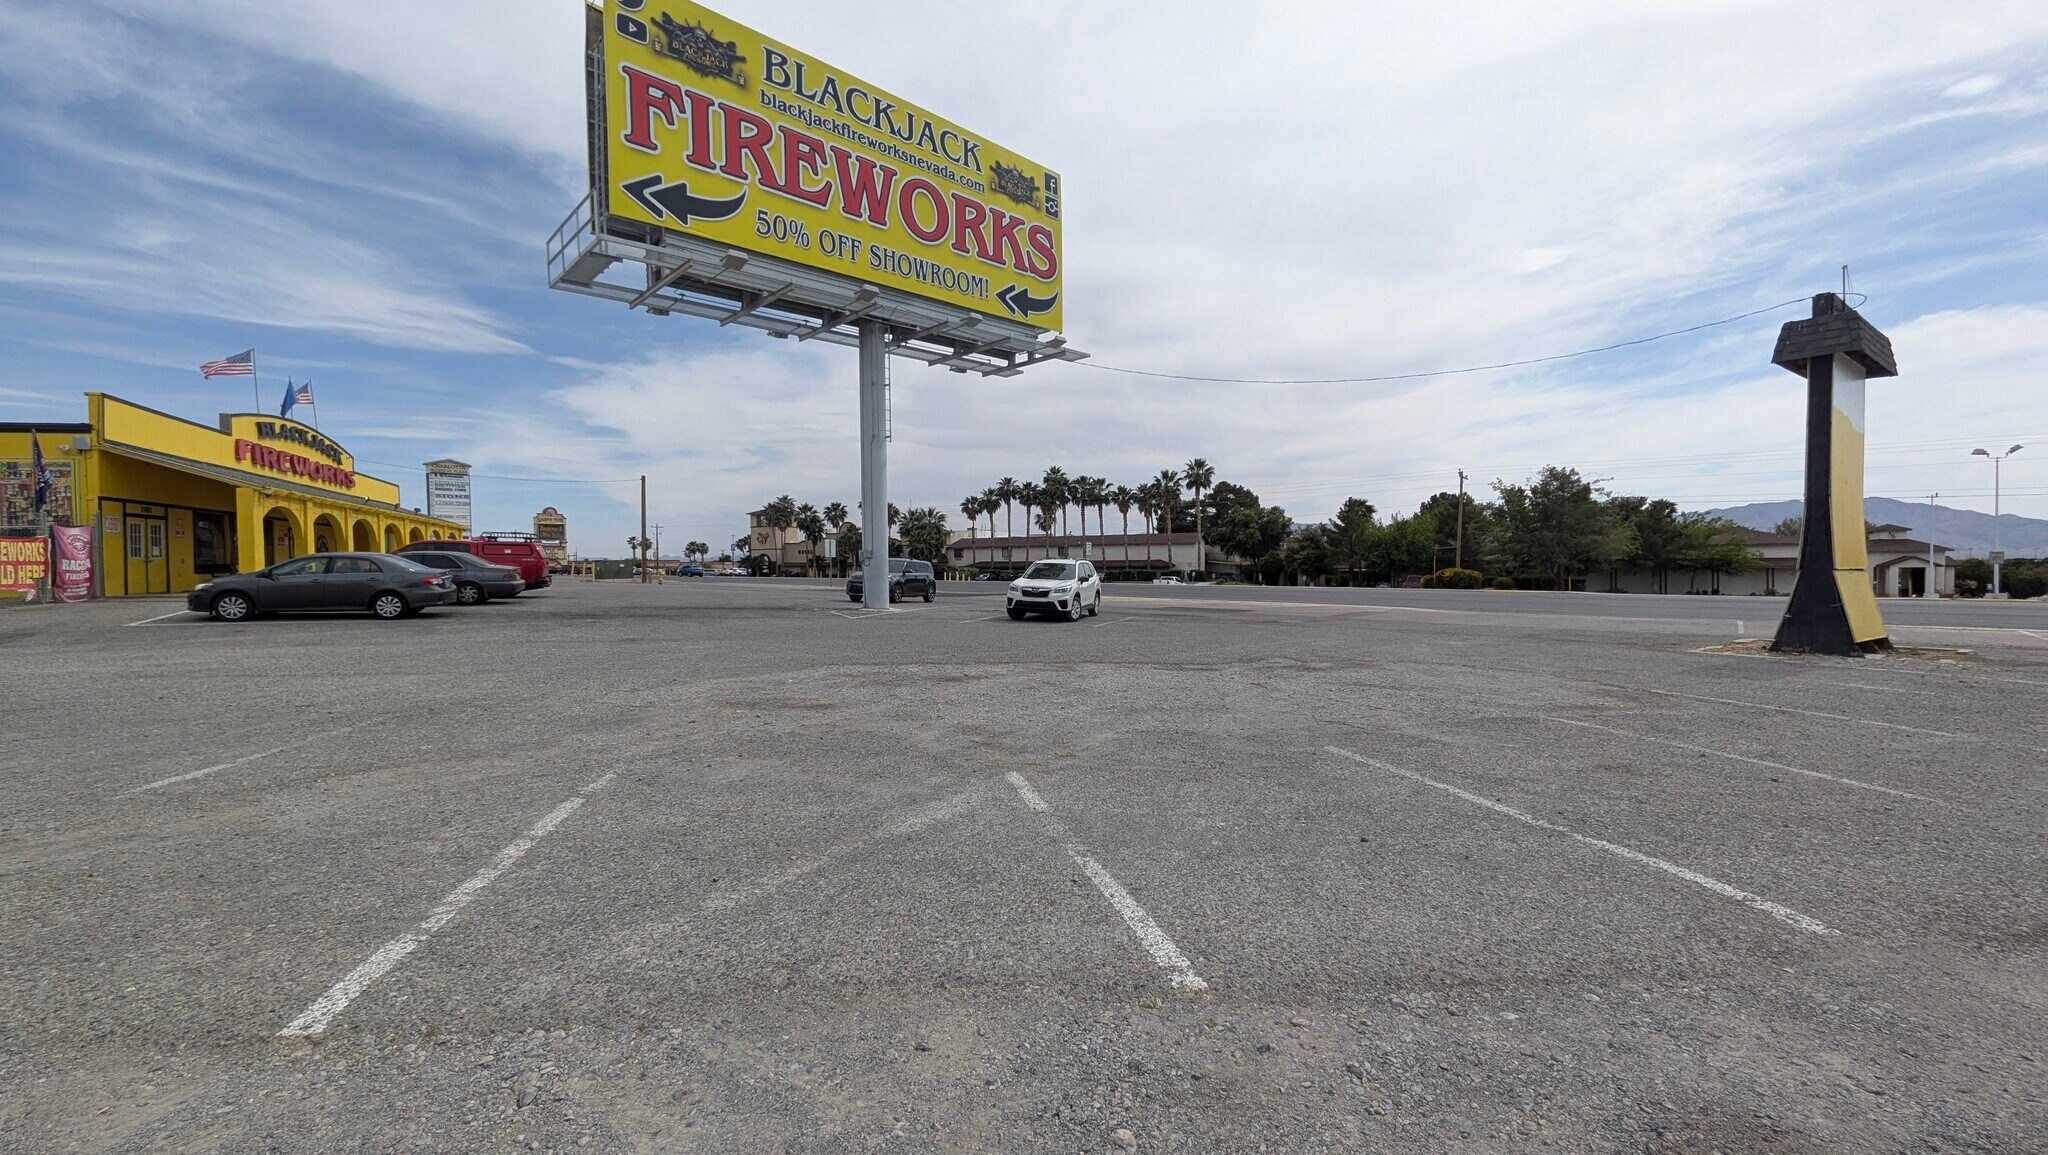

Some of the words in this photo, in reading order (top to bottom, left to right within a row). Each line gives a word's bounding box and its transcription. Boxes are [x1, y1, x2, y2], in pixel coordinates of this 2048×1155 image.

[760, 89, 985, 193] blackjackfireworksnevada.com
[762, 45, 984, 174] BLACKJACK
[622, 66, 1058, 280] FIREWORKS
[756, 208, 810, 248] 50%
[819, 229, 863, 261] OFF
[869, 244, 990, 299] SHOWROOM!
[235, 438, 356, 488] FIREWORKS
[256, 422, 343, 465] BLACKJACK
